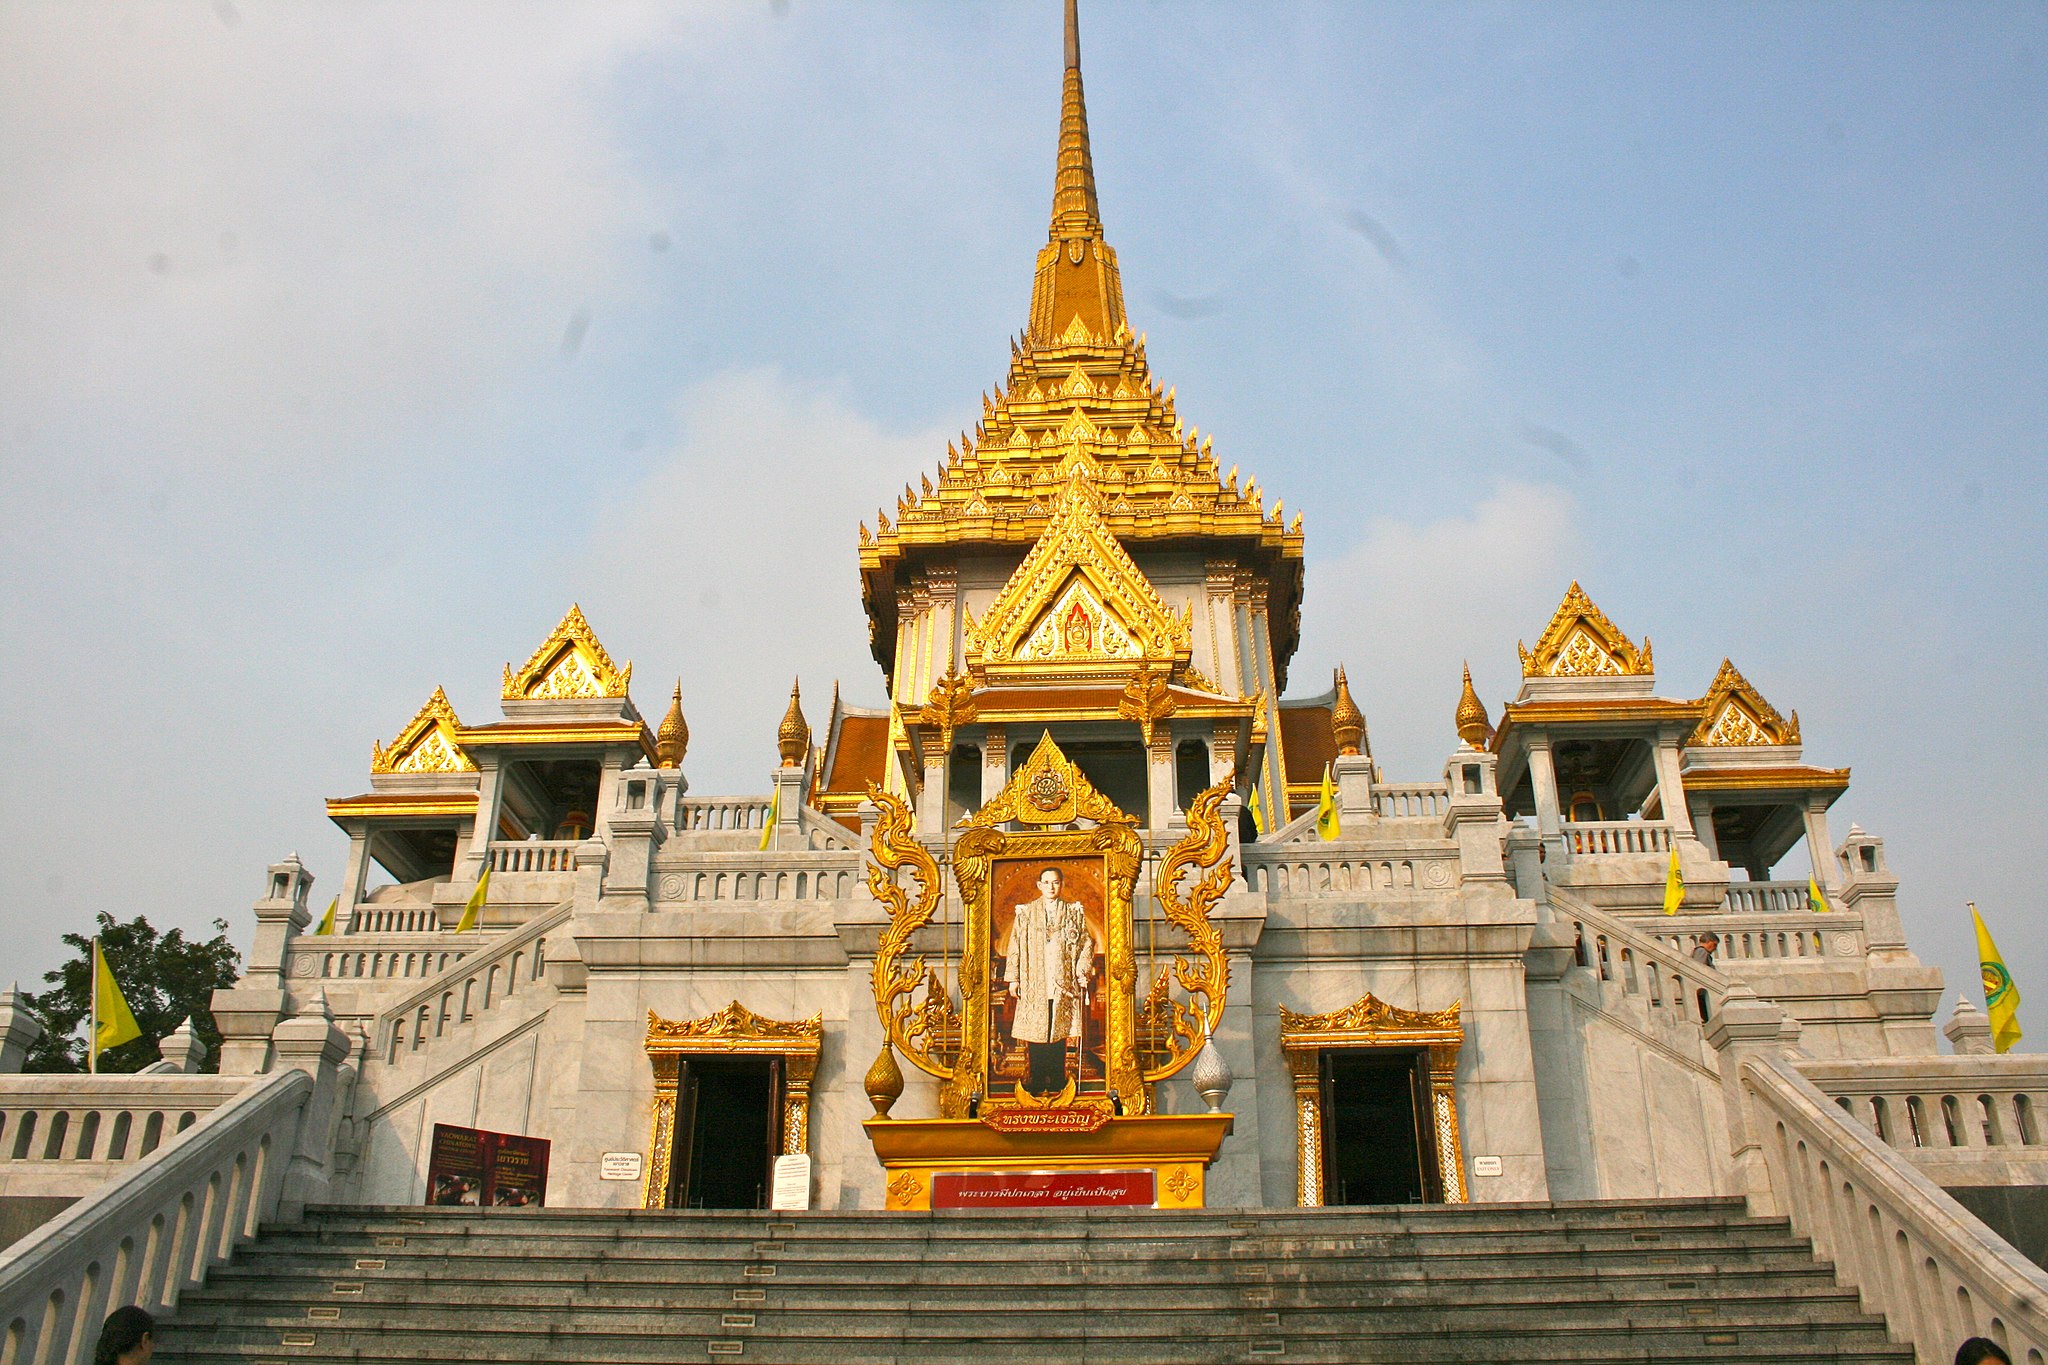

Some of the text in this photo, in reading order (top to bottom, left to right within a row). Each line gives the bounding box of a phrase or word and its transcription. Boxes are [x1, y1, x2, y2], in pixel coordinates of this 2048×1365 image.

[1002, 1111, 1090, 1127] ทรงพระเจริญ
[958, 1185, 1128, 1200] พระบารมีปกเกล้า อยู่เย็นเป็นสุข
